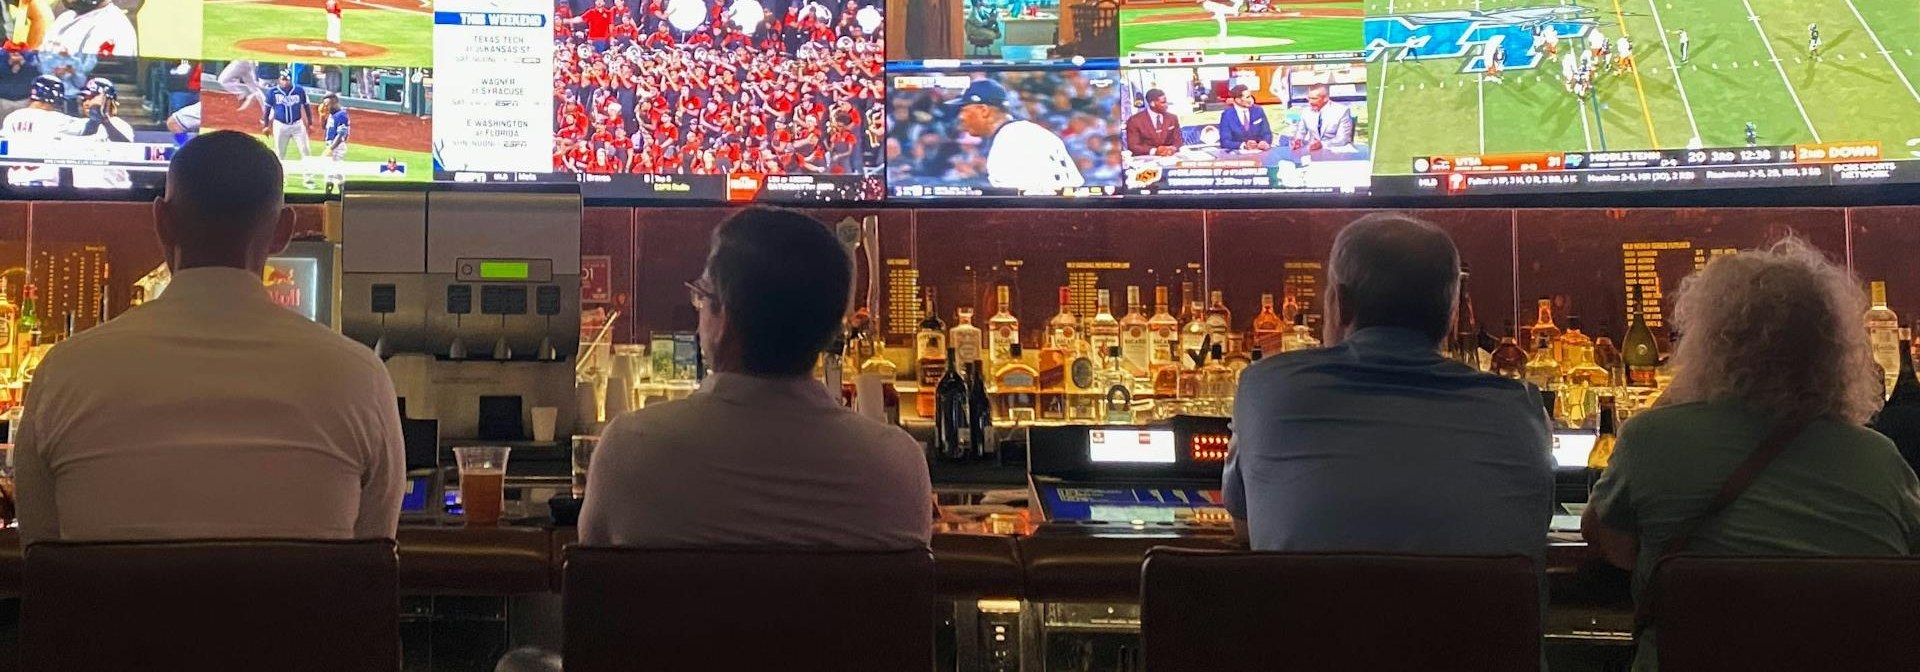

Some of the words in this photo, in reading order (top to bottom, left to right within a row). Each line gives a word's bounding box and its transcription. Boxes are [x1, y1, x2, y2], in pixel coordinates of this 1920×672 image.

[504, 36, 524, 44] TECH
[481, 78, 515, 86] WAGNER
[475, 120, 528, 128] WASHINGTON
[1829, 145, 1878, 159] DOWN
[1841, 171, 1889, 179] NETWORK
